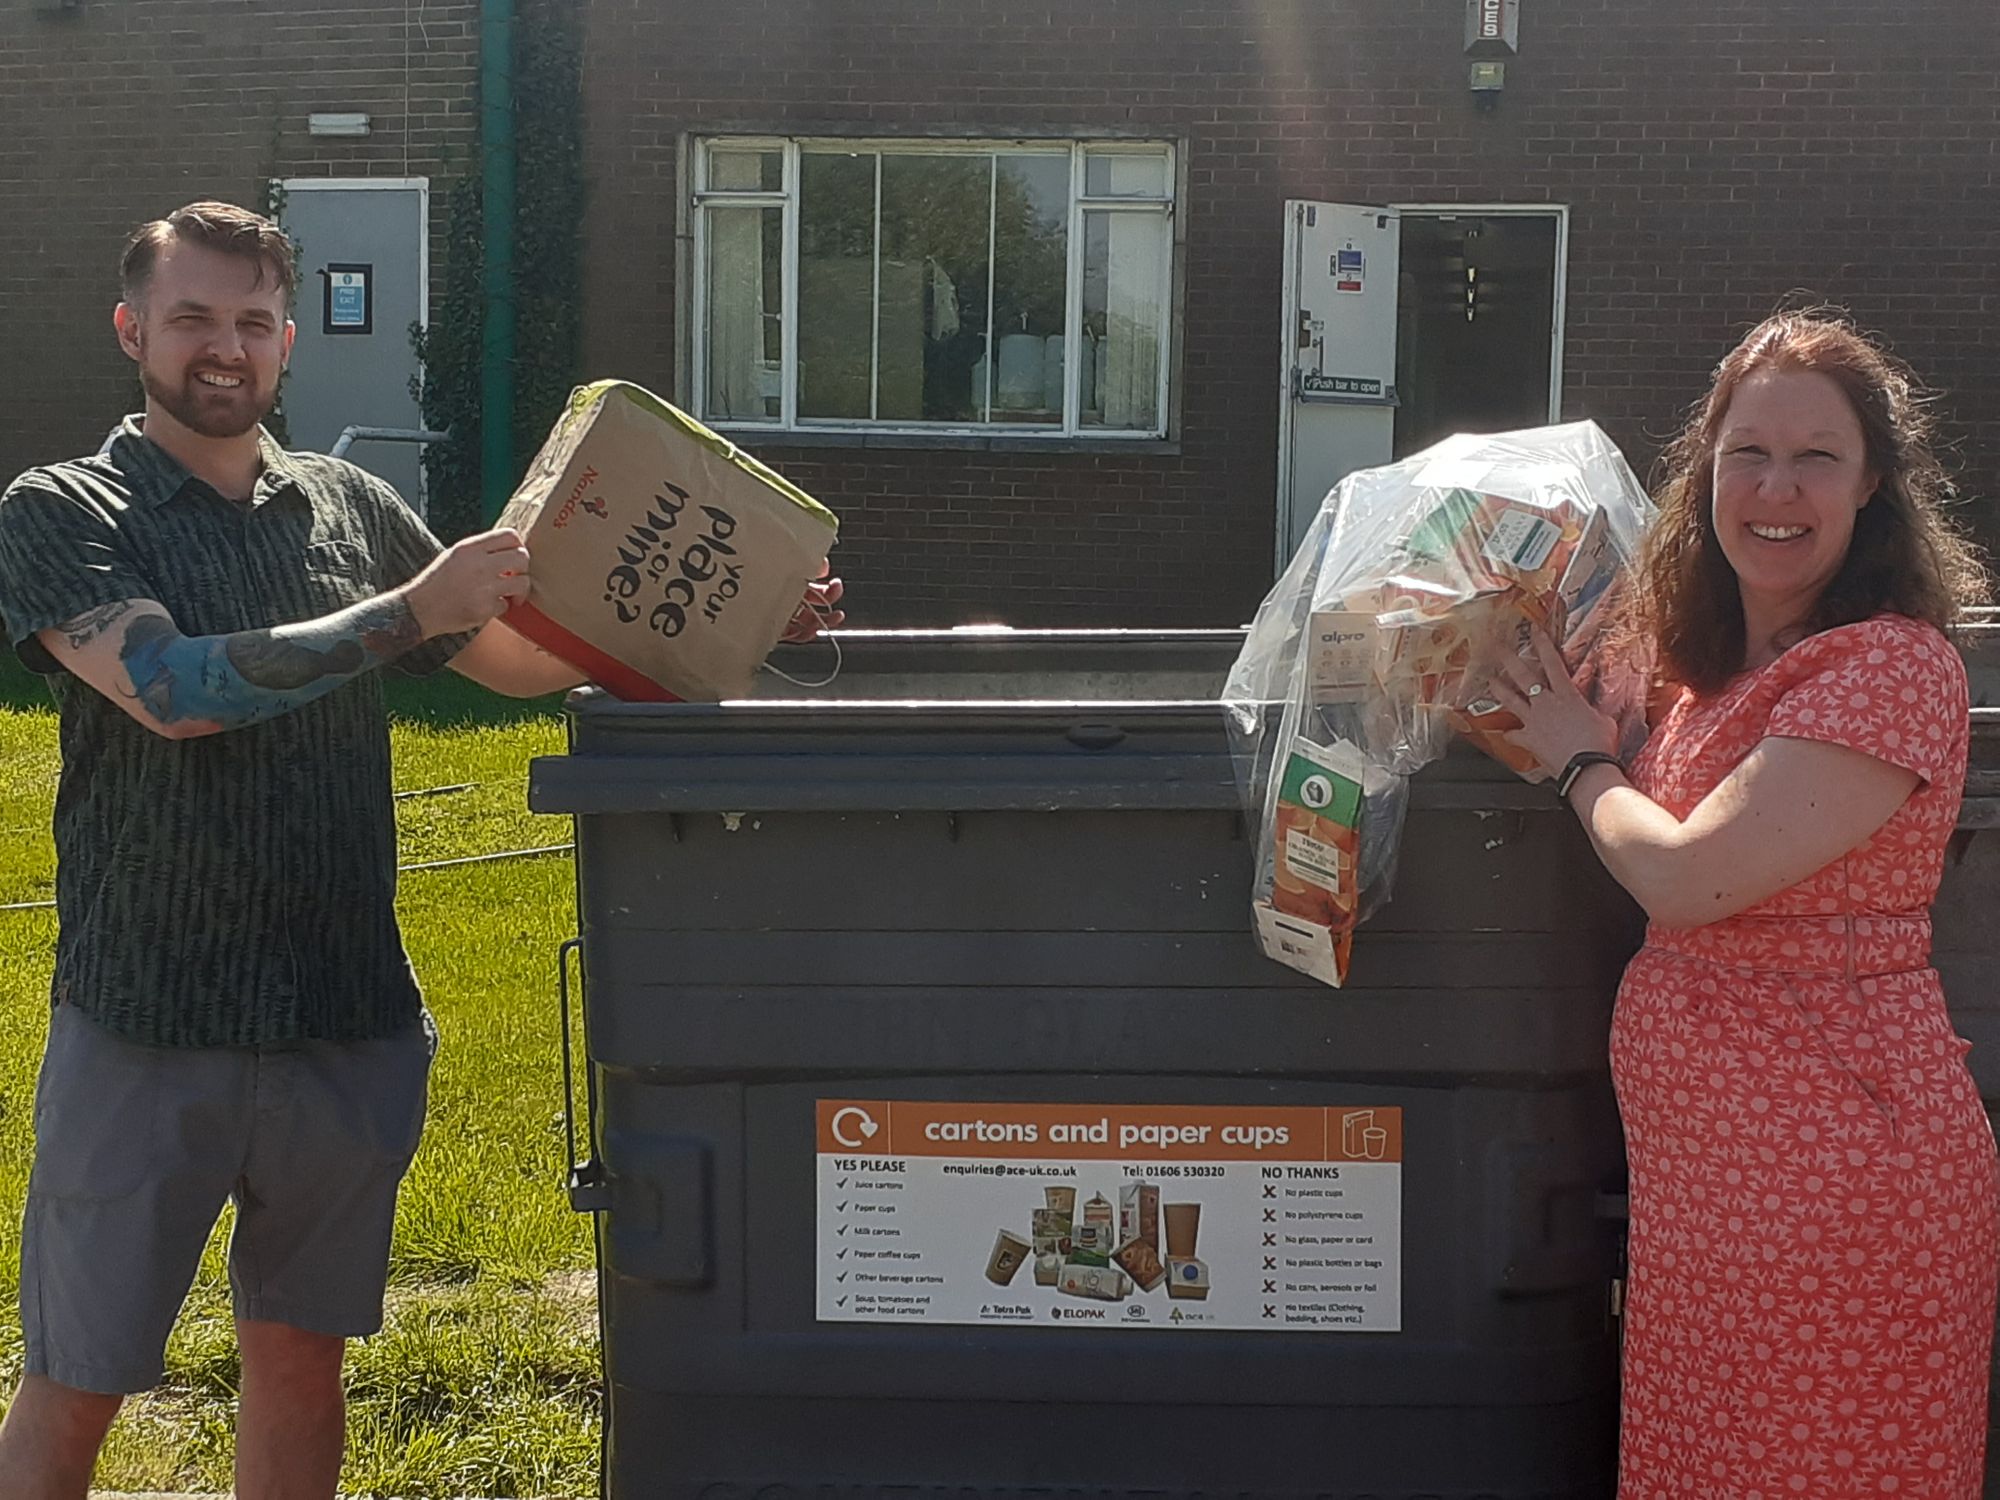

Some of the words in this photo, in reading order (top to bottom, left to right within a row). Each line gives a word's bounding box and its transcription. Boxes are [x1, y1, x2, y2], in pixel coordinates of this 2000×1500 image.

[1336, 380, 1348, 390] bar
[1350, 381, 1358, 391] to
[1360, 383, 1379, 392] open
[554, 466, 599, 528] Nando's
[604, 481, 691, 623] mine?
[647, 554, 669, 584] or
[650, 505, 736, 638] place
[702, 562, 744, 624] your
[1322, 630, 1365, 644] alpro
[924, 1120, 1038, 1142] cartons
[1048, 1118, 1108, 1143] and
[1120, 1124, 1212, 1149] paper
[1220, 1126, 1290, 1150] cups
[834, 1160, 856, 1171] YES
[860, 1160, 906, 1172] PLEASE
[943, 1164, 1077, 1176] enquiries@ace-uk.co.uk
[1122, 1166, 1143, 1177] Tel:
[1146, 1166, 1180, 1177] 01606
[1184, 1166, 1225, 1177] 530320
[1262, 1167, 1282, 1178] NO
[1287, 1168, 1340, 1179] THANKS
[855, 1181, 873, 1189] Juice
[875, 1182, 903, 1190] cartons
[1286, 1189, 1296, 1197] No
[1299, 1190, 1322, 1198] plastic
[1324, 1190, 1343, 1198] cups
[854, 1204, 876, 1212] Paper
[1298, 1212, 1343, 1220] polystyrene
[1344, 1212, 1363, 1220] cups
[872, 1228, 900, 1236] cartons
[1321, 1237, 1344, 1245] paper
[1356, 1236, 1372, 1244] card
[854, 1250, 876, 1258] Paper
[878, 1250, 901, 1258] coffee
[903, 1252, 920, 1260] cups
[1299, 1259, 1323, 1268] plastic
[1325, 1259, 1352, 1267] bottles
[1364, 1260, 1382, 1268] bags
[855, 1273, 877, 1281] Other
[879, 1274, 914, 1284] beverage
[915, 1275, 944, 1283] cartons
[1320, 1284, 1352, 1292] aerosols
[1364, 1284, 1376, 1292] foil
[878, 1296, 914, 1304] tomatoes
[916, 1296, 930, 1304] and
[878, 1306, 895, 1314] food
[994, 1305, 1014, 1313] Tetra
[1015, 1306, 1031, 1314] Pak
[1063, 1309, 1106, 1319] ELOPAK
